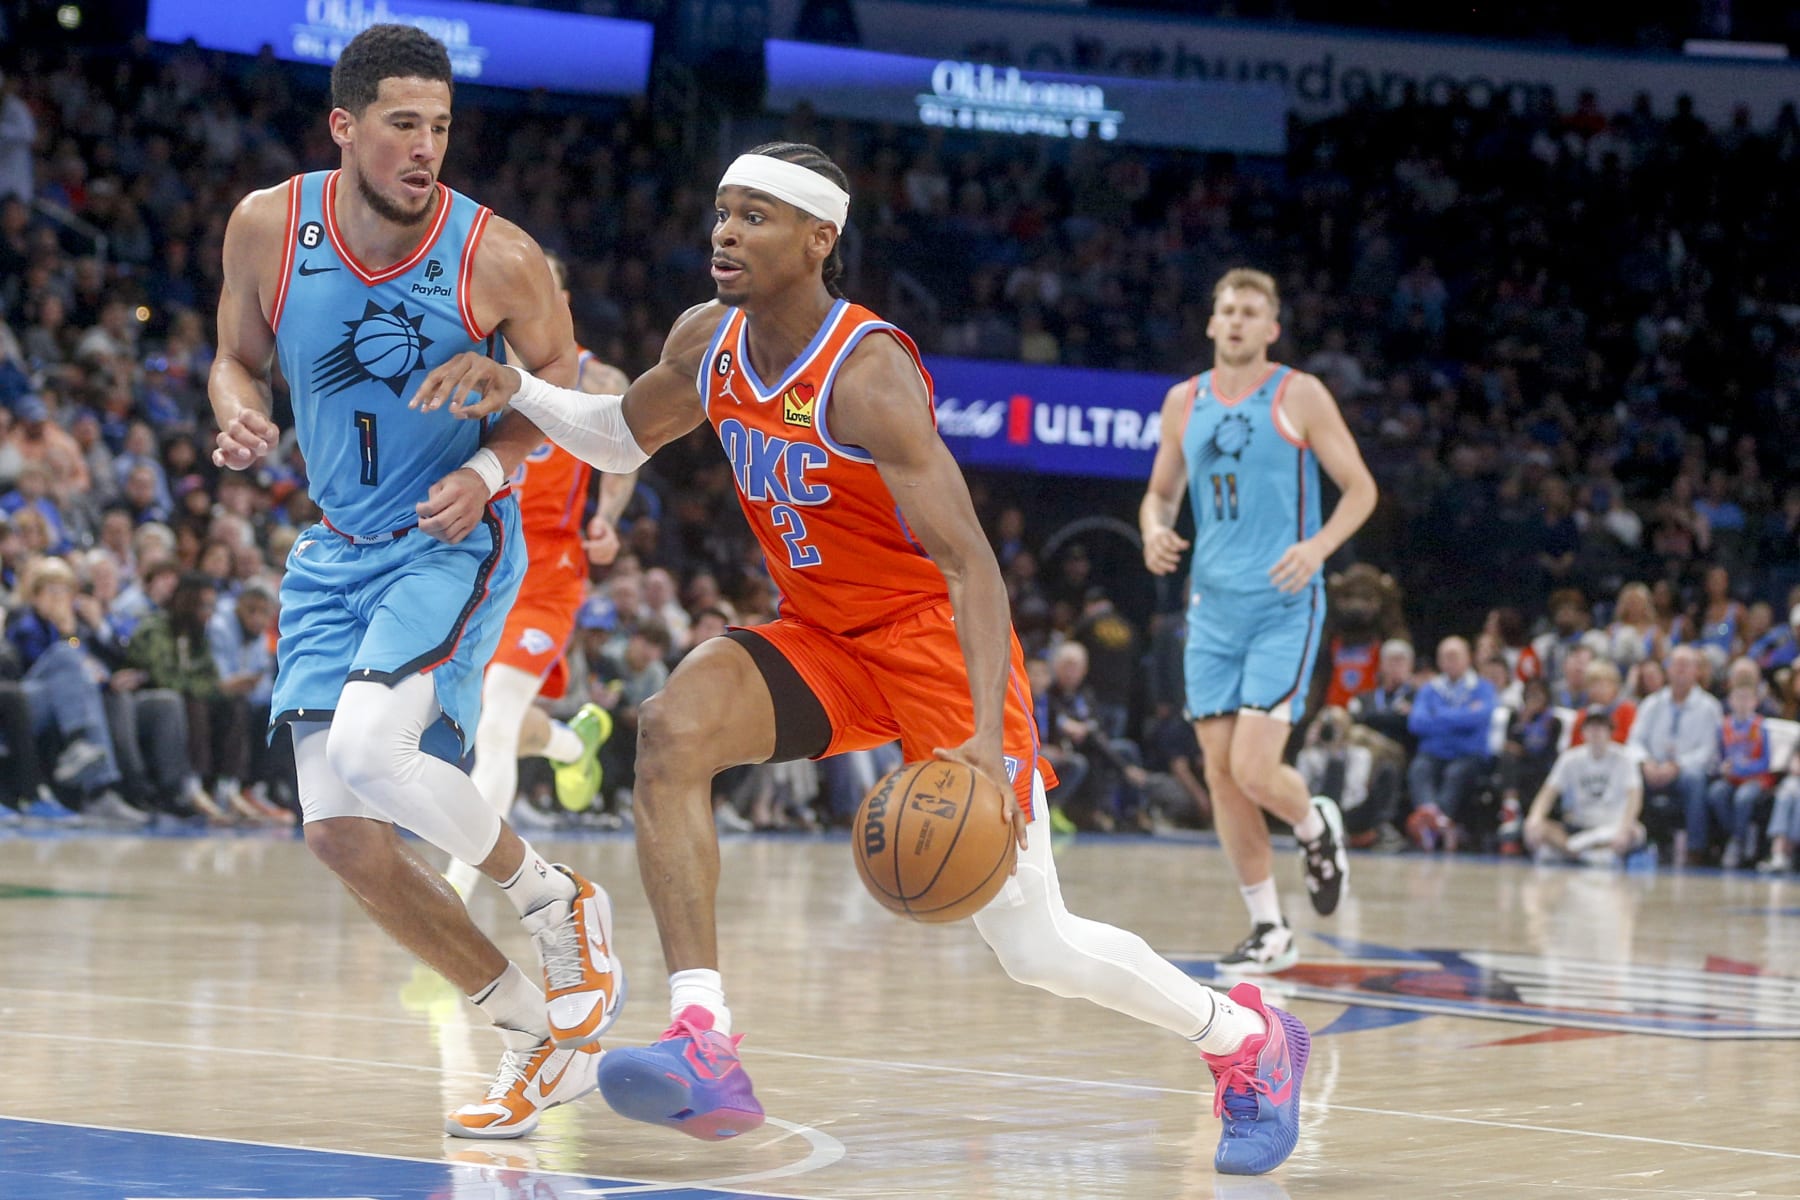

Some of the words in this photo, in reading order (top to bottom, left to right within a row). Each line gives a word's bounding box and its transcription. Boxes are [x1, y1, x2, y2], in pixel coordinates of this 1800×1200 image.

[304, 225, 319, 247] 6
[411, 283, 452, 297] PayPal
[719, 353, 731, 374] 6
[354, 411, 379, 487] 1
[719, 418, 831, 506] OKC
[1210, 472, 1239, 521] 11
[771, 504, 822, 568] 2
